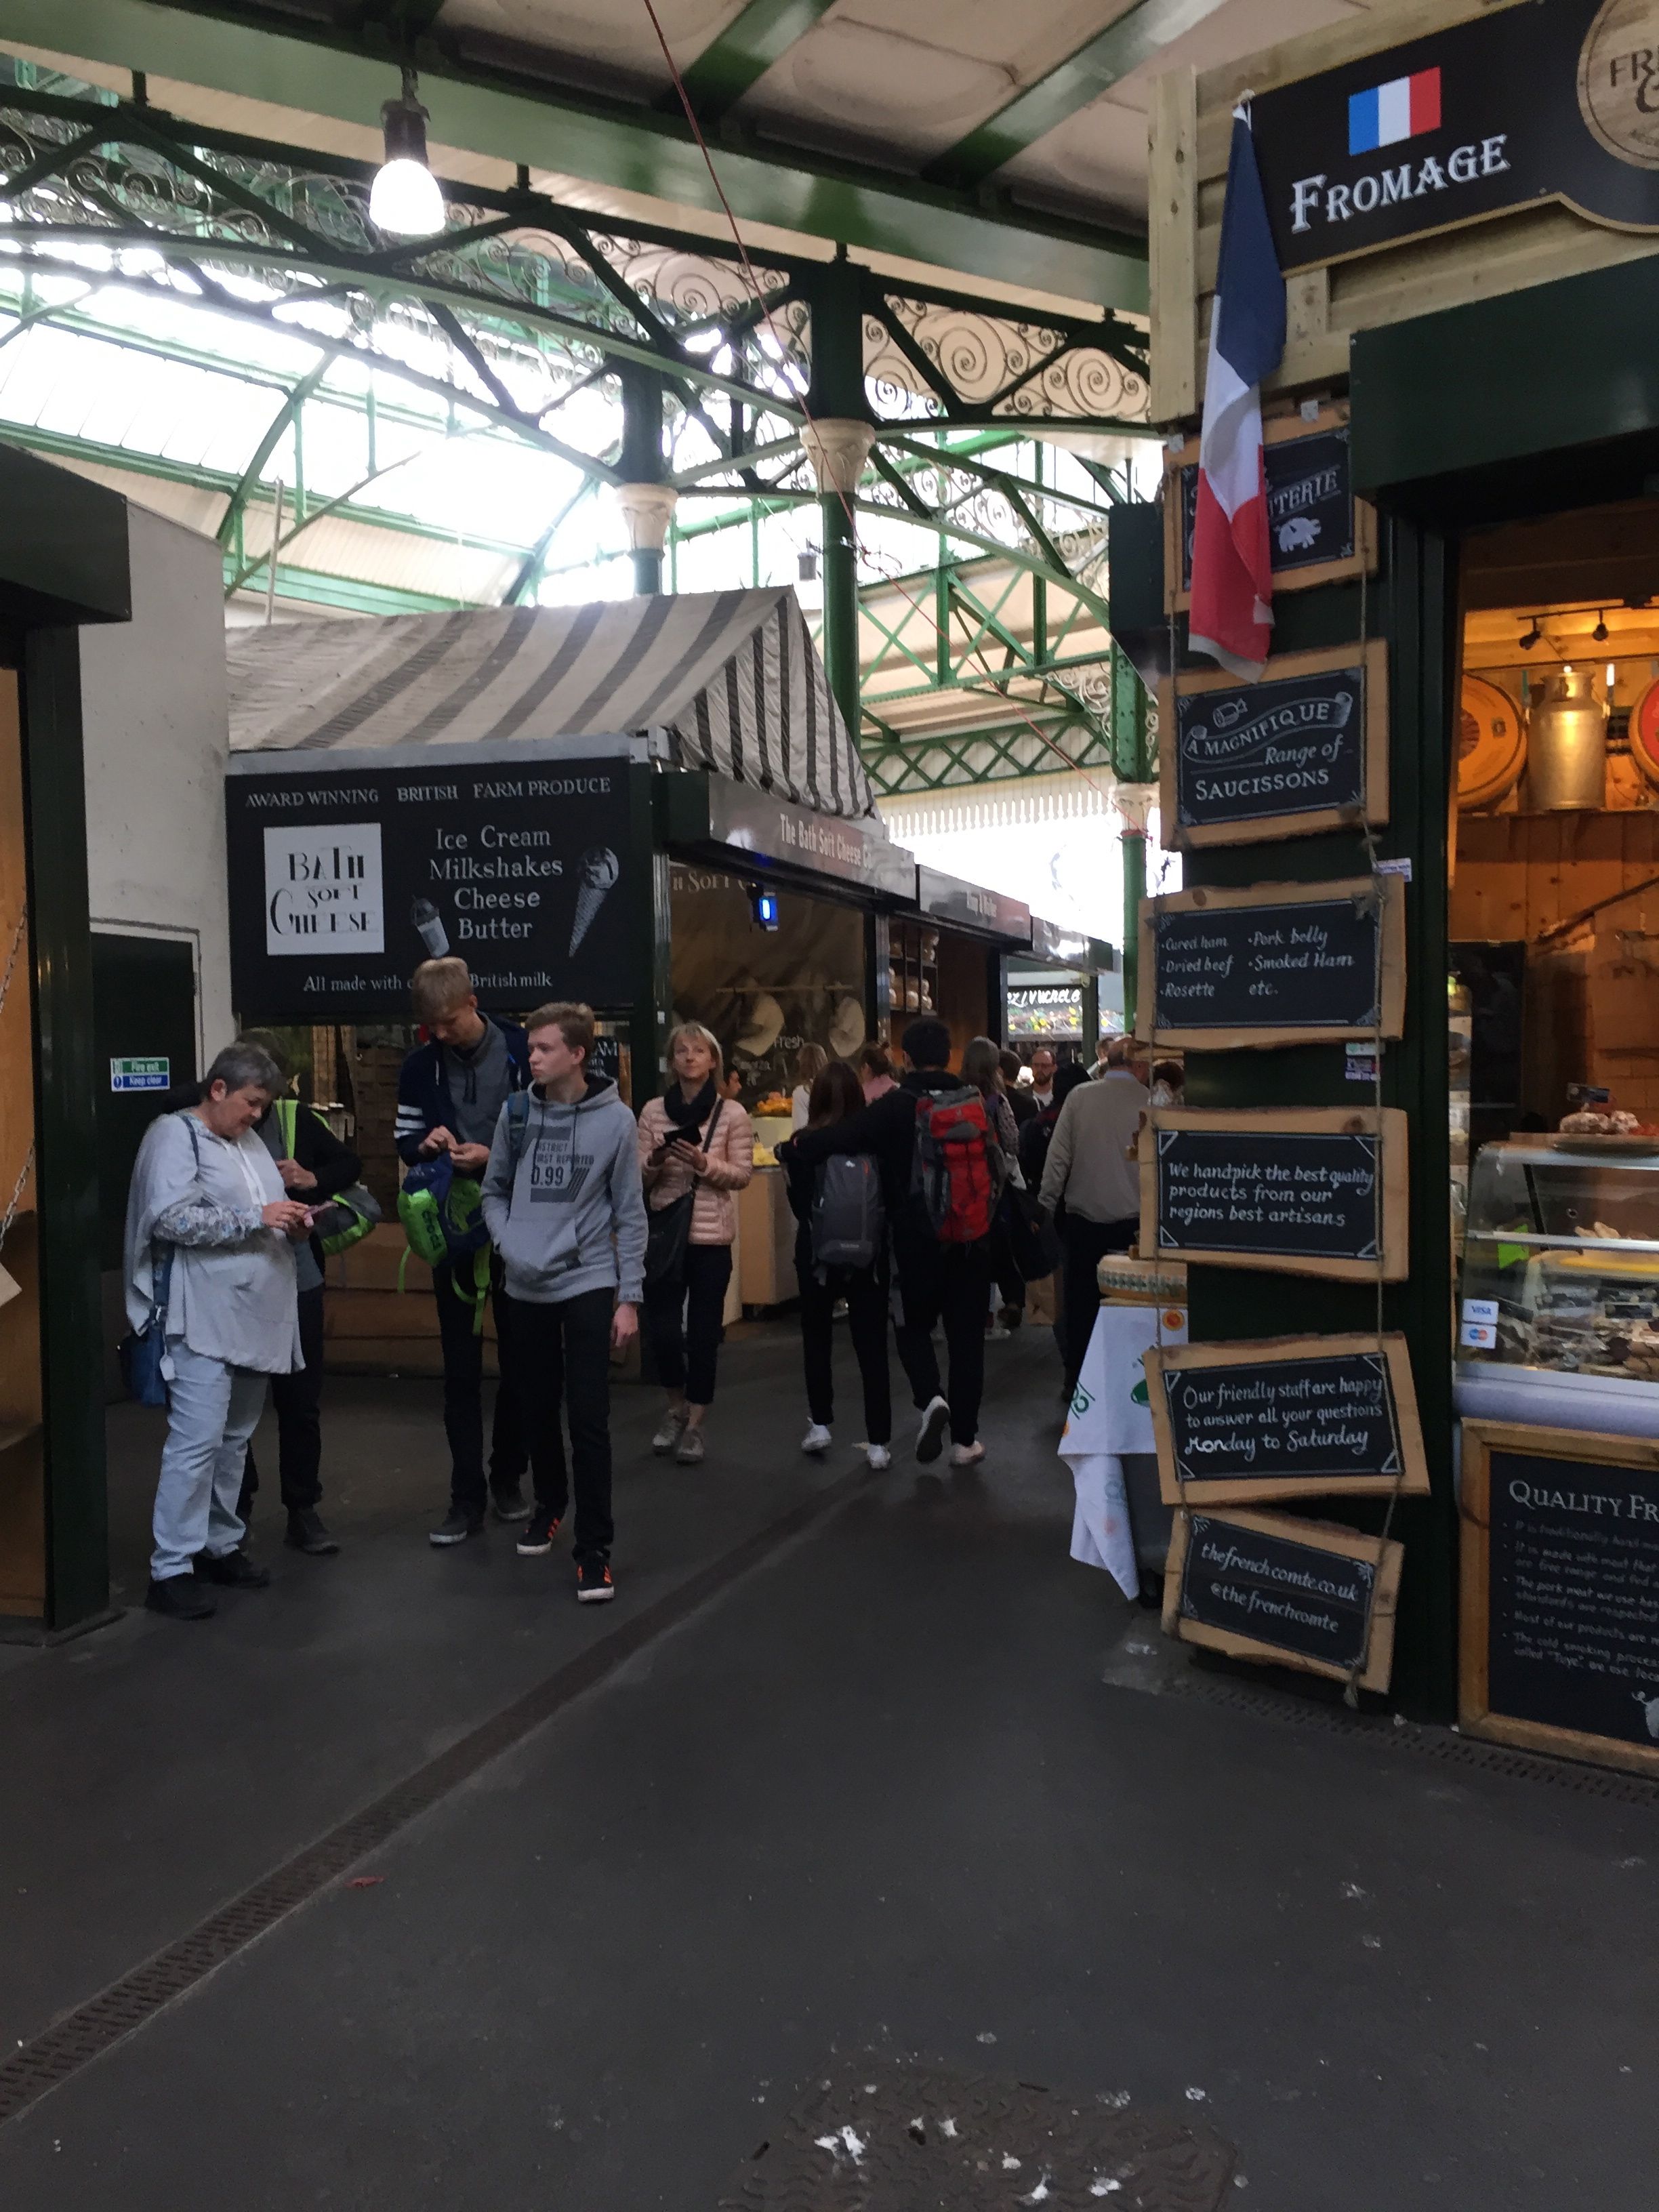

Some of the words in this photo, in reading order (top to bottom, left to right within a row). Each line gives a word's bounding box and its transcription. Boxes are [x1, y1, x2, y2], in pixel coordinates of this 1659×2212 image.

[1290, 134, 1511, 234] FROMAGE
[1187, 739, 1198, 755] A
[1204, 703, 1330, 756] MAGNIFIQUE
[1265, 745, 1317, 769] Range
[1322, 733, 1344, 763] of
[245, 791, 304, 807] AWARD
[308, 788, 380, 805] WINNING
[397, 785, 459, 802] BRITISH
[474, 781, 523, 798] FARM
[529, 777, 611, 796] PRODUCE
[1195, 769, 1330, 801] SAUCISSONS
[436, 828, 468, 851] Ice
[480, 825, 551, 846] Cream
[780, 813, 796, 846] The
[798, 820, 817, 852] Bath
[288, 845, 365, 881] BATH
[430, 854, 563, 880] Milkshakes
[306, 882, 363, 909] SOFT
[454, 888, 541, 909] Cheese
[270, 887, 380, 935] CHEESE
[458, 917, 533, 940] Butter
[1254, 929, 1286, 947] Pork
[1290, 925, 1328, 951] belly
[1166, 956, 1201, 973] Dried
[1204, 955, 1233, 979] beef
[1254, 951, 1309, 971] Smoked
[304, 976, 327, 991] All
[331, 975, 367, 991] made
[371, 974, 403, 989] with
[470, 972, 518, 988] British
[520, 970, 553, 987] milk
[1164, 982, 1215, 998] Rosette
[1168, 1163, 1189, 1178] We
[1193, 1163, 1263, 1186] handpick
[1265, 1164, 1292, 1181] the
[1294, 1166, 1328, 1181] best
[1330, 1167, 1374, 1196] quality
[1169, 1183, 1247, 1202] products
[1254, 1183, 1294, 1202] from
[1300, 1190, 1333, 1202] our
[1169, 1202, 1224, 1226] regions
[1229, 1205, 1263, 1222] best
[1269, 1207, 1345, 1227] artisans
[1471, 1306, 1492, 1315] VISA
[1183, 1385, 1214, 1409] Our
[1216, 1381, 1275, 1409] friendly
[1278, 1378, 1311, 1399] staff
[1313, 1384, 1335, 1397] are
[1339, 1376, 1382, 1402] happy
[1185, 1414, 1201, 1429] to
[1204, 1412, 1253, 1426] answer
[1258, 1407, 1278, 1424] all
[1282, 1410, 1313, 1429] your
[1317, 1403, 1383, 1424] questions
[1185, 1432, 1256, 1462] Monday
[1261, 1433, 1280, 1450] to
[1288, 1425, 1368, 1456] Saturday
[1509, 1479, 1622, 1519] QUALITY
